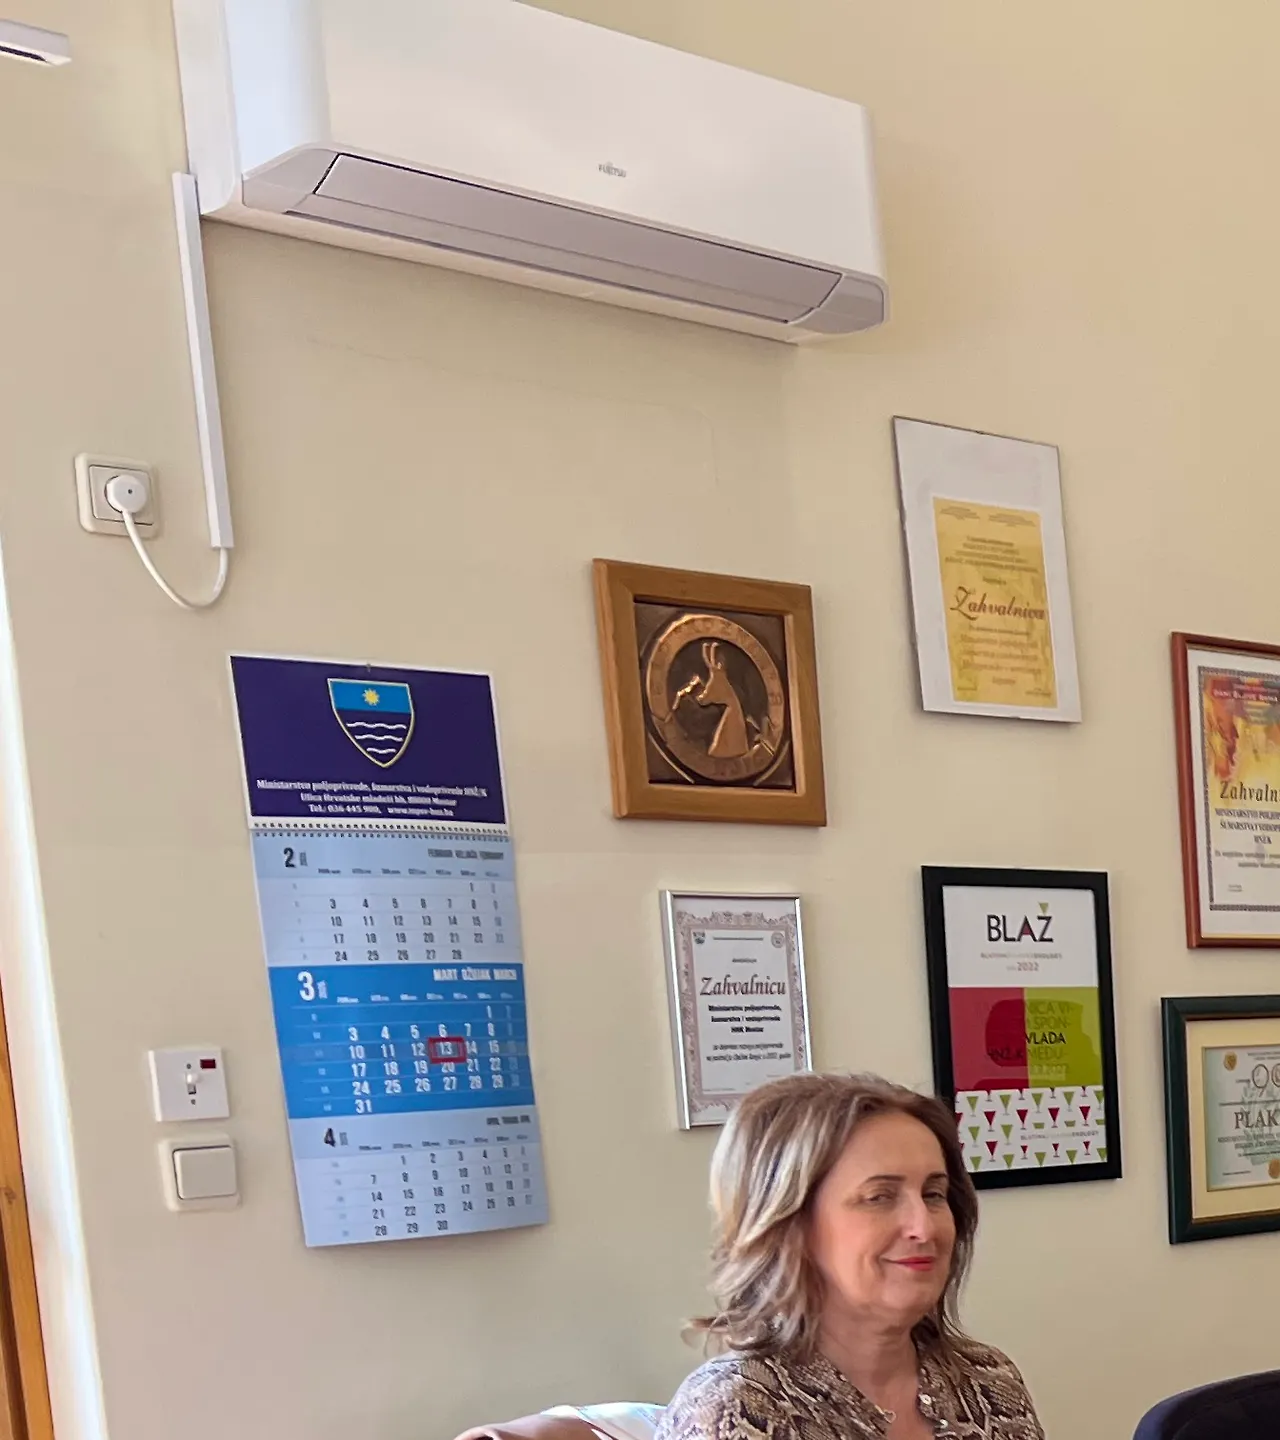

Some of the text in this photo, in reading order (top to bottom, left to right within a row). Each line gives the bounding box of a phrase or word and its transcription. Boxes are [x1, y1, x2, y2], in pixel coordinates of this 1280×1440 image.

[950, 586, 1045, 621] Zahvalnica
[283, 847, 296, 868] 2
[329, 898, 336, 909] 3
[362, 898, 369, 908] 4
[330, 916, 343, 927] 10
[363, 915, 375, 926] 11
[393, 915, 404, 926] 12
[987, 902, 1054, 943] BLAŽ
[333, 933, 344, 944] 17
[334, 951, 348, 962] 24
[367, 950, 380, 961] 25
[426, 949, 436, 960] 27
[297, 971, 315, 1001] 3
[700, 974, 786, 996] Zahvalnicu
[486, 1005, 492, 1019] 1
[348, 1026, 359, 1041] 3
[381, 1025, 390, 1040] 4
[410, 1024, 420, 1039] 5
[438, 1023, 448, 1038] 6
[464, 1022, 472, 1037] 7
[487, 1022, 495, 1037] 8
[1025, 1031, 1066, 1045] VLADA
[349, 1045, 366, 1060] 10
[380, 1043, 396, 1058] 11
[411, 1042, 426, 1057] 12
[440, 1041, 452, 1055] 13
[465, 1040, 478, 1055] 14
[488, 1040, 500, 1054] 15
[351, 1062, 367, 1078] 17
[383, 1061, 399, 1076] 18
[413, 1060, 428, 1074] 19
[441, 1062, 455, 1074] 20
[467, 1059, 479, 1072] 21
[352, 1080, 370, 1096] 24
[384, 1079, 402, 1094] 25
[414, 1078, 431, 1093] 26
[442, 1076, 457, 1091] 27
[354, 1099, 373, 1114] 31
[323, 1127, 336, 1148] 4
[401, 1155, 406, 1165] 1
[430, 1153, 436, 1164] 2
[483, 1149, 488, 1159] 4
[370, 1174, 377, 1184] 7
[432, 1169, 439, 1180] 9
[371, 1191, 383, 1202] 14
[403, 1189, 414, 1199] 15
[372, 1208, 385, 1220] 21
[404, 1206, 416, 1217] 22
[434, 1203, 446, 1214] 23
[462, 1201, 473, 1211] 24
[374, 1220, 448, 1236] 28 29 30
